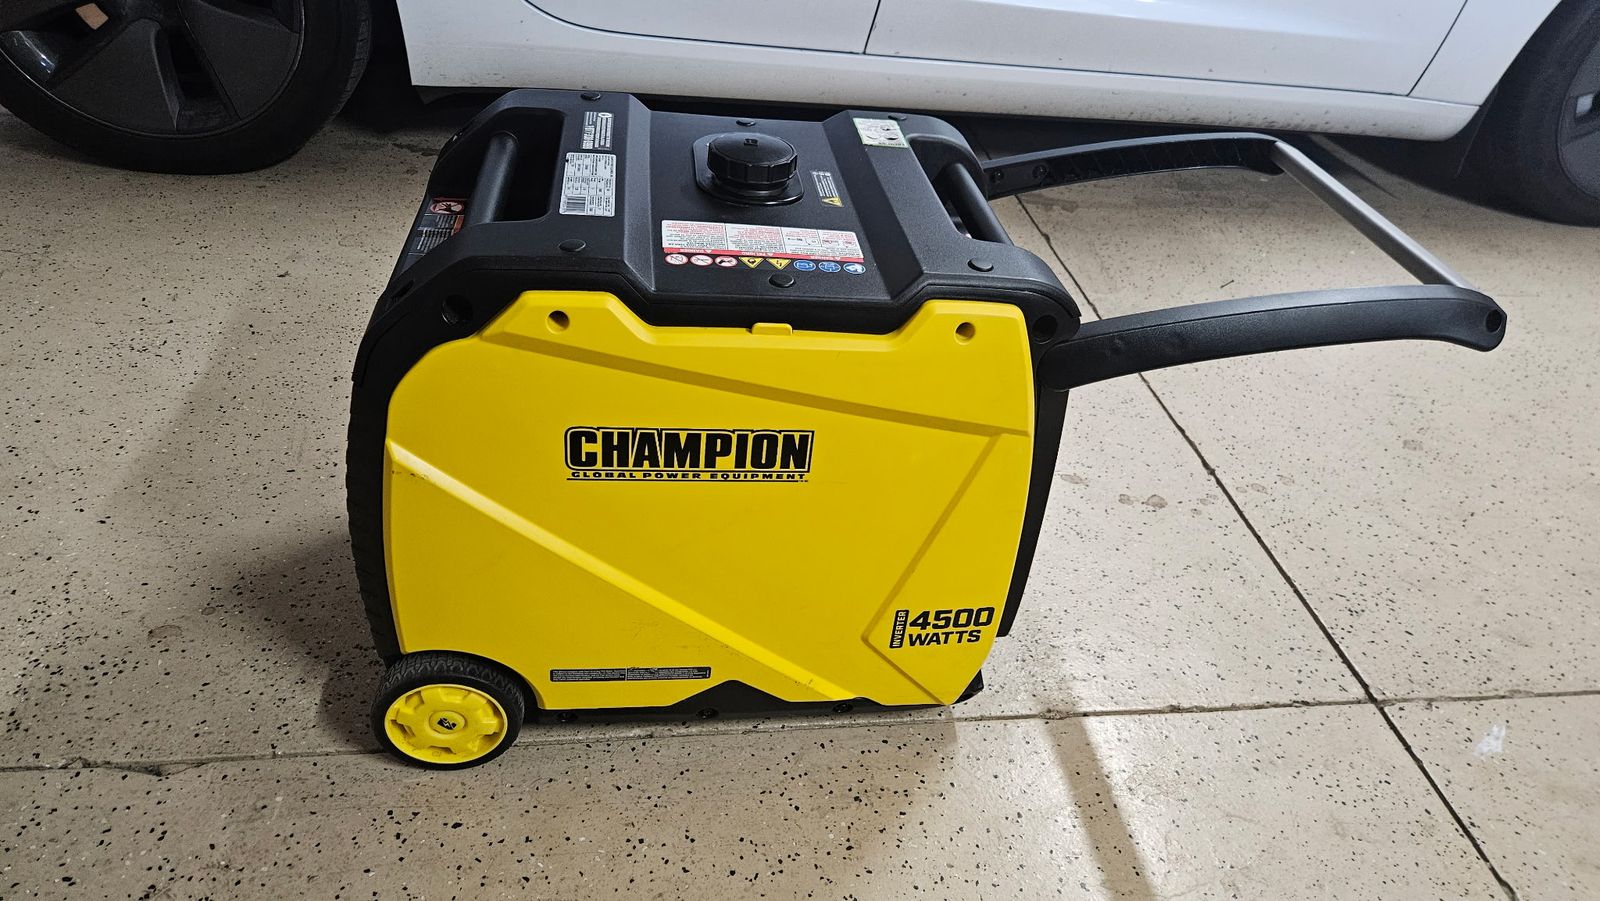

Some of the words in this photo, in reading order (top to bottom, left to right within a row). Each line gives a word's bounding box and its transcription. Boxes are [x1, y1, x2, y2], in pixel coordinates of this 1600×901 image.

[567, 428, 812, 471] CHAMPION
[571, 471, 636, 479] GLOBAL
[892, 611, 907, 647] INVERTER
[909, 607, 995, 630] 4500
[908, 630, 982, 646] WATTS
